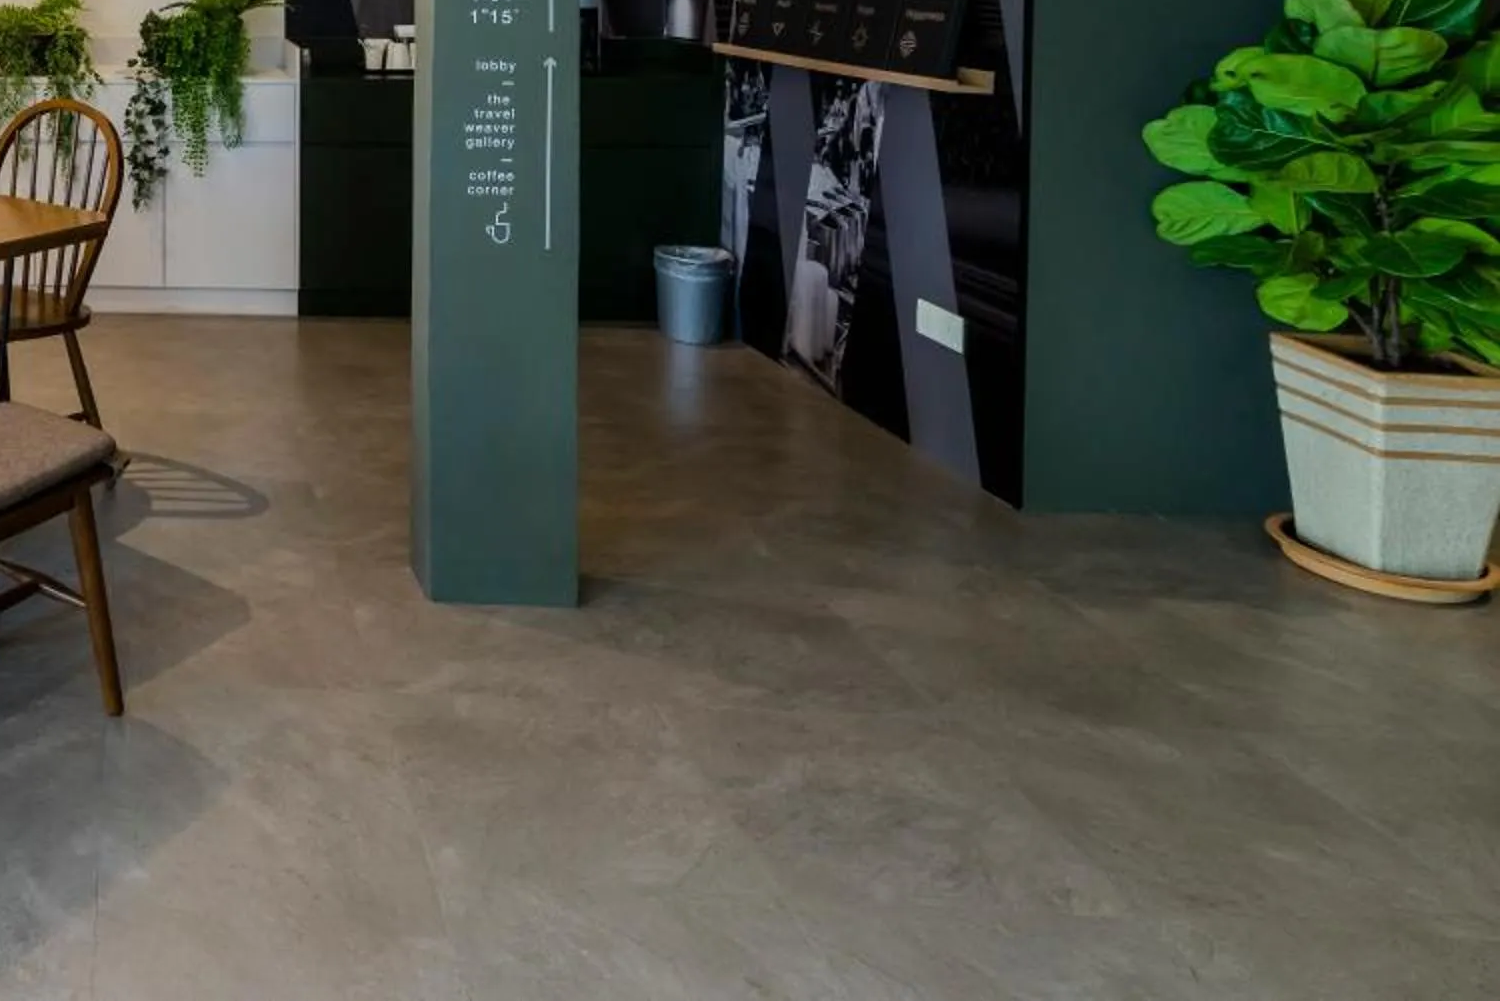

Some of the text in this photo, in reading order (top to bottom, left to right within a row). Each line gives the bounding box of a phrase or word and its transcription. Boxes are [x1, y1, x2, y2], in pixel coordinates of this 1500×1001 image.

[475, 60, 517, 73] lobby
[487, 94, 510, 105] the
[474, 109, 516, 120] travel
[464, 123, 516, 134] weaver
[465, 136, 516, 150] gallery
[469, 170, 515, 182] coffee
[467, 185, 515, 196] corner
